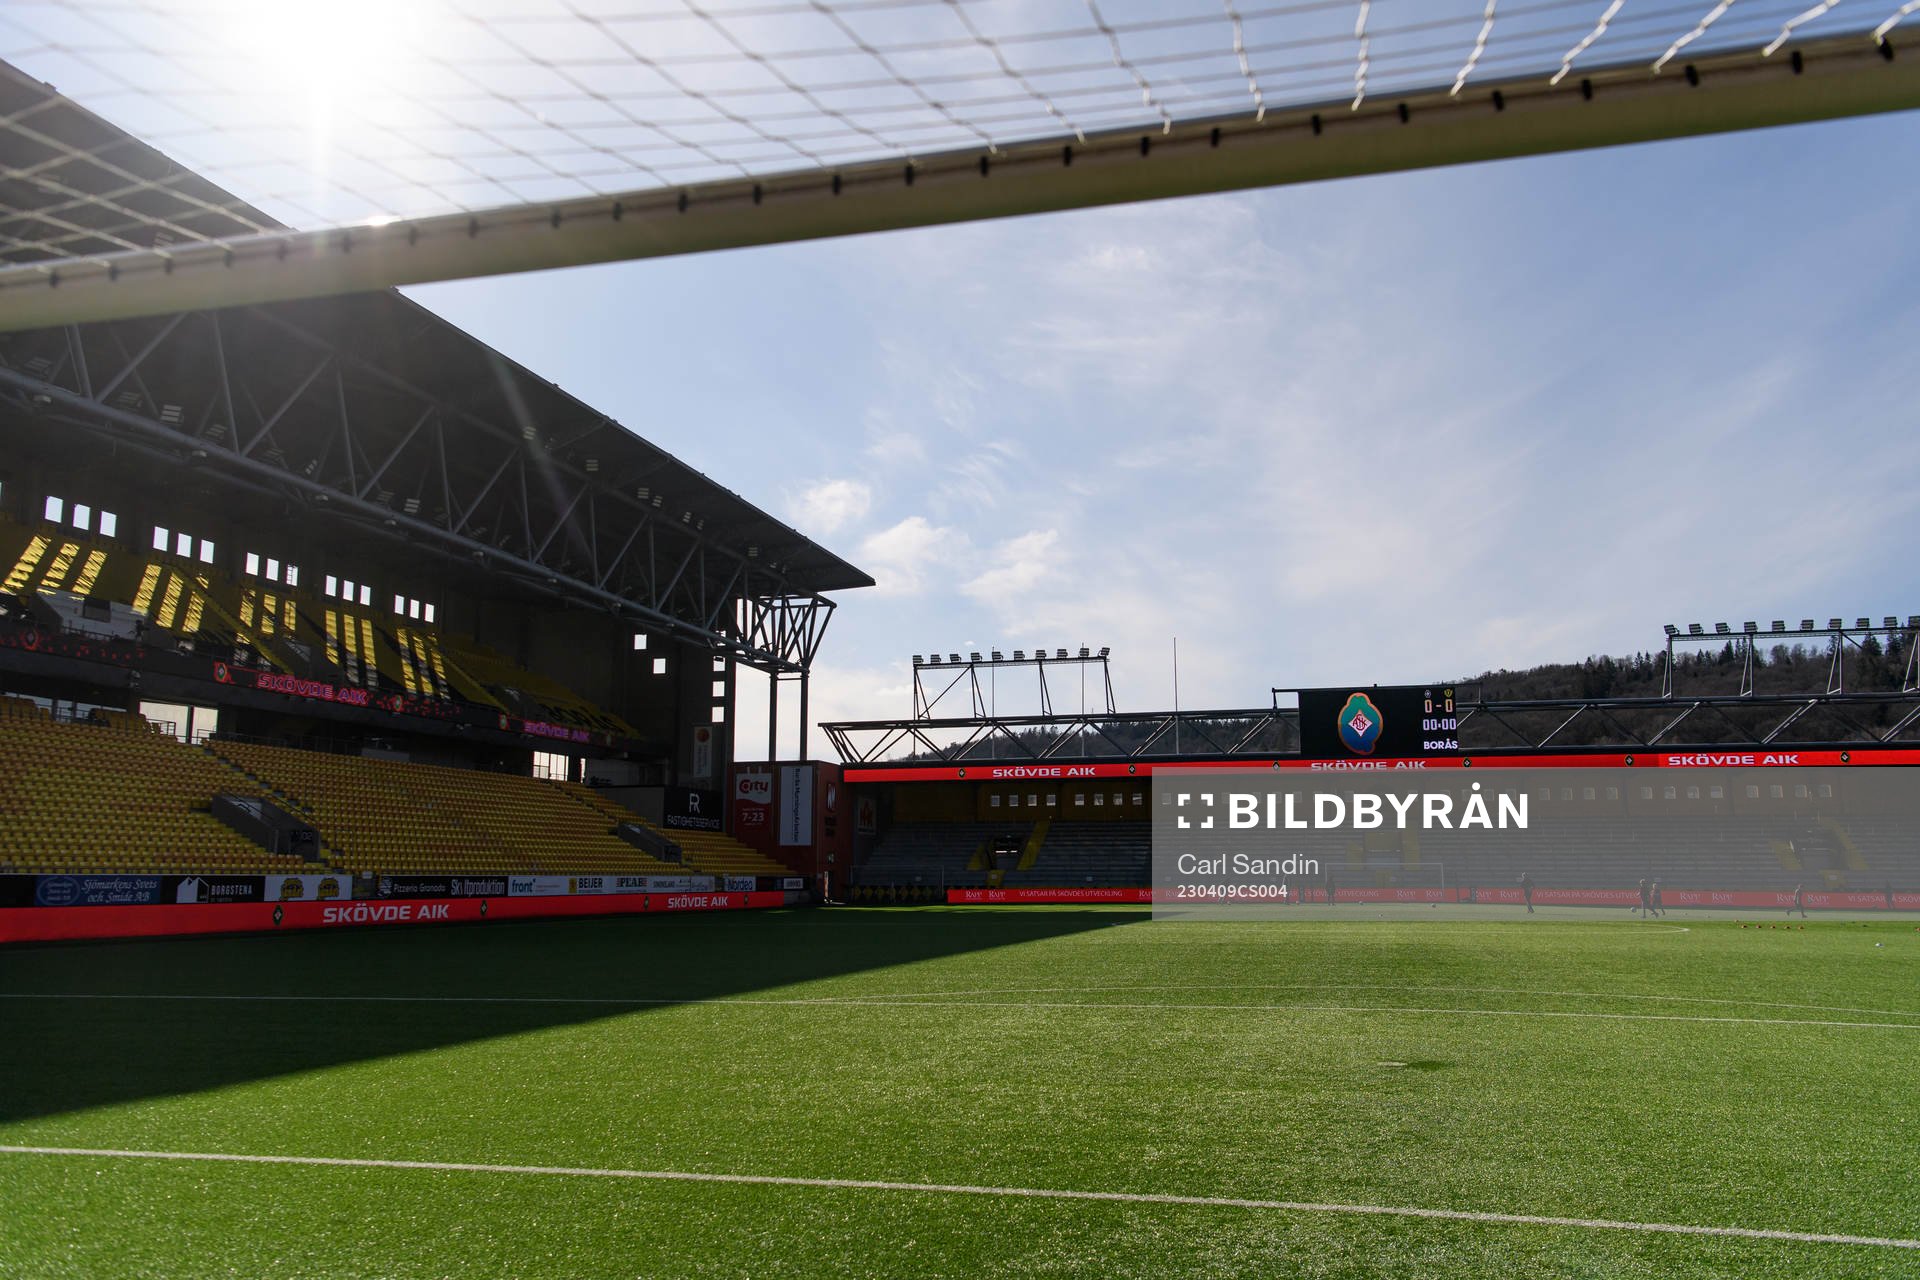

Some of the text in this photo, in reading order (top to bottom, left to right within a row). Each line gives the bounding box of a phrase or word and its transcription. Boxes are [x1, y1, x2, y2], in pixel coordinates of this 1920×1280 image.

[256, 673, 368, 705] SKÖVDE AIK
[1423, 738, 1459, 750] BORÅS
[1310, 760, 1427, 771] SKÖVDE AIK
[1668, 753, 1799, 765] SKÖVDE AIK
[992, 767, 1096, 778] SKÖVDE AIK
[739, 779, 768, 794] City
[741, 810, 765, 823] 7-23
[511, 879, 534, 893] front
[578, 878, 603, 889] BEIJER
[620, 877, 643, 888] PEAB
[728, 878, 753, 891] Nordea
[211, 883, 253, 897] BORGSTENA
[667, 894, 729, 909] SKÖVDE AIK
[322, 902, 450, 923] SKÖVDE AIK
